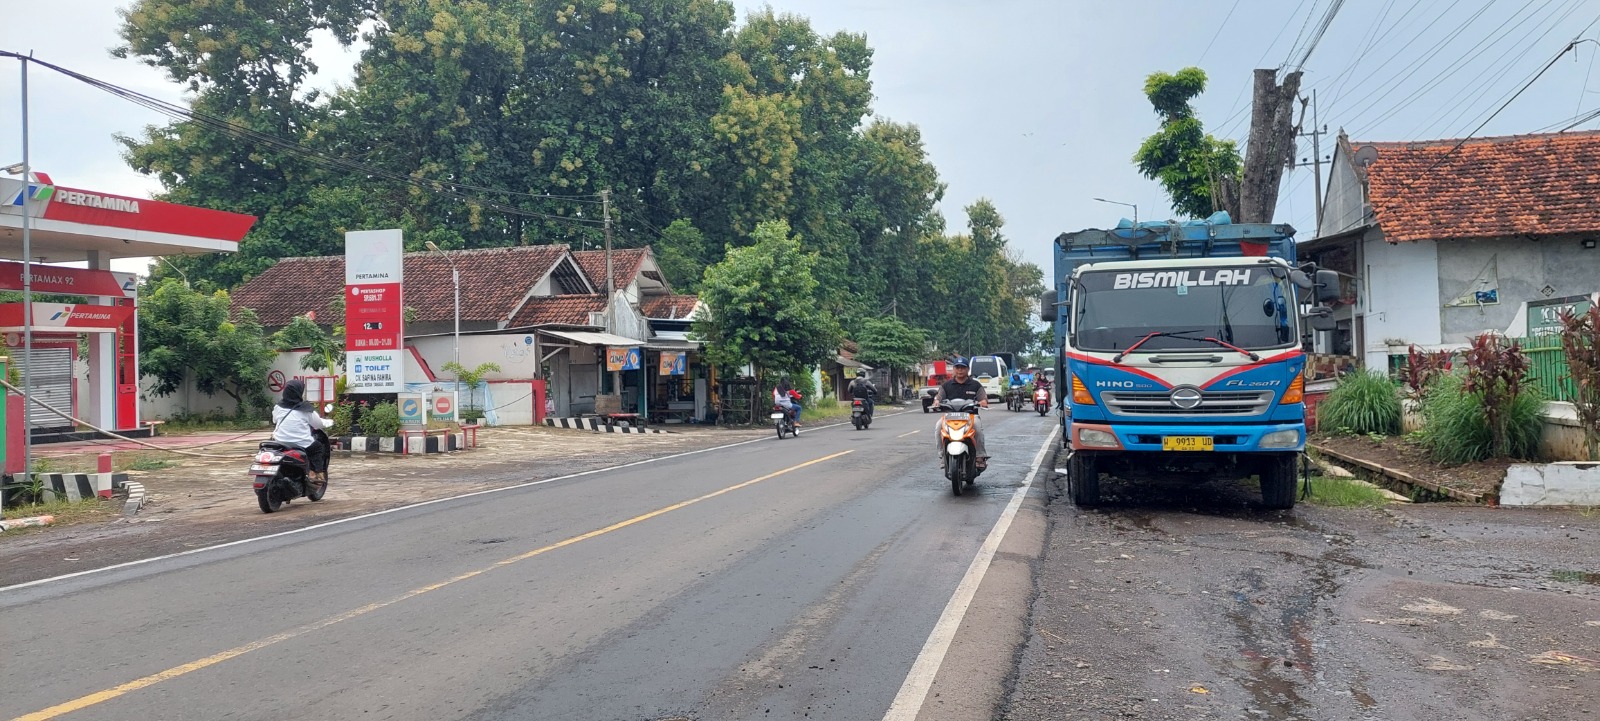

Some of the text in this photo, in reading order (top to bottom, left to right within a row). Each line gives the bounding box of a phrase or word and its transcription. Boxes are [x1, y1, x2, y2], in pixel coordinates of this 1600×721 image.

[57, 190, 140, 214] PERTAMINA
[20, 274, 74, 286] PRTAMAX 92
[1114, 270, 1250, 290] BISMILLAH
[1164, 438, 1168, 446] W
[1202, 437, 1212, 446] UD
